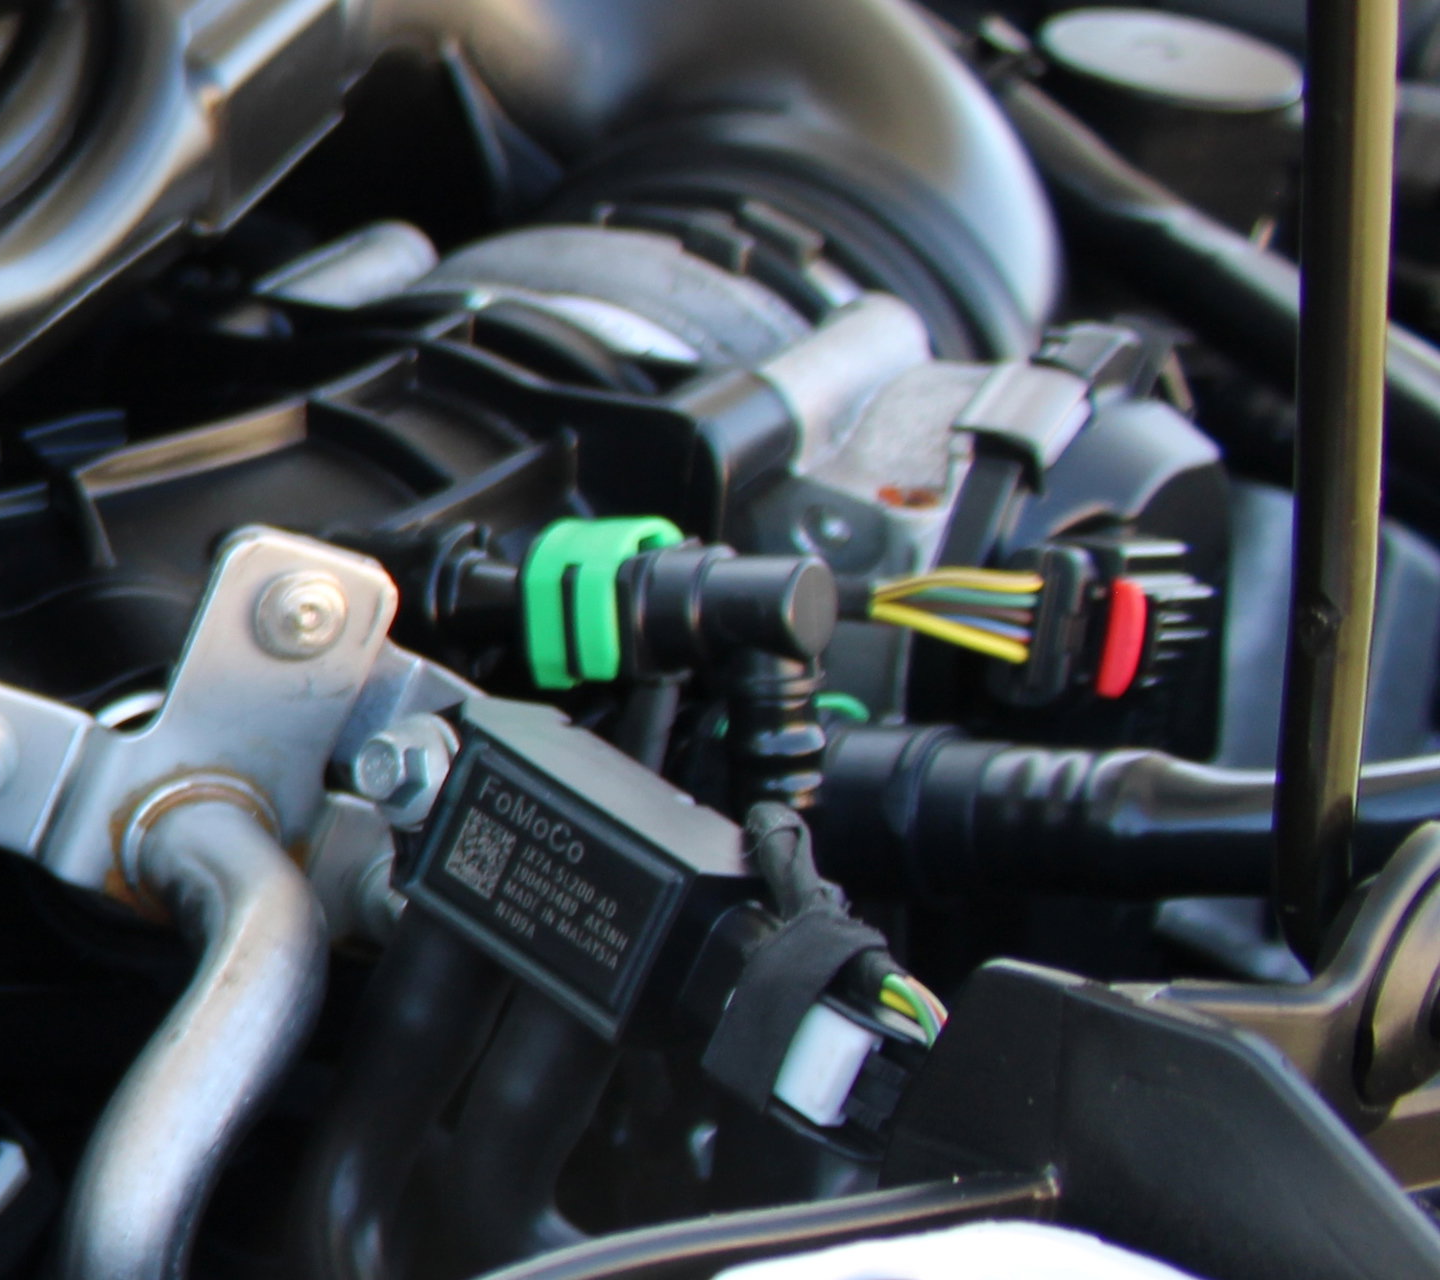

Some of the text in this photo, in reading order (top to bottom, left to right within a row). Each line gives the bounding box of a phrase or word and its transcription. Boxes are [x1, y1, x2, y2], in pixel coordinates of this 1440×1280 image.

[479, 775, 585, 865] FoMoCo
[502, 879, 619, 970] MADE IN MALAYSIA
